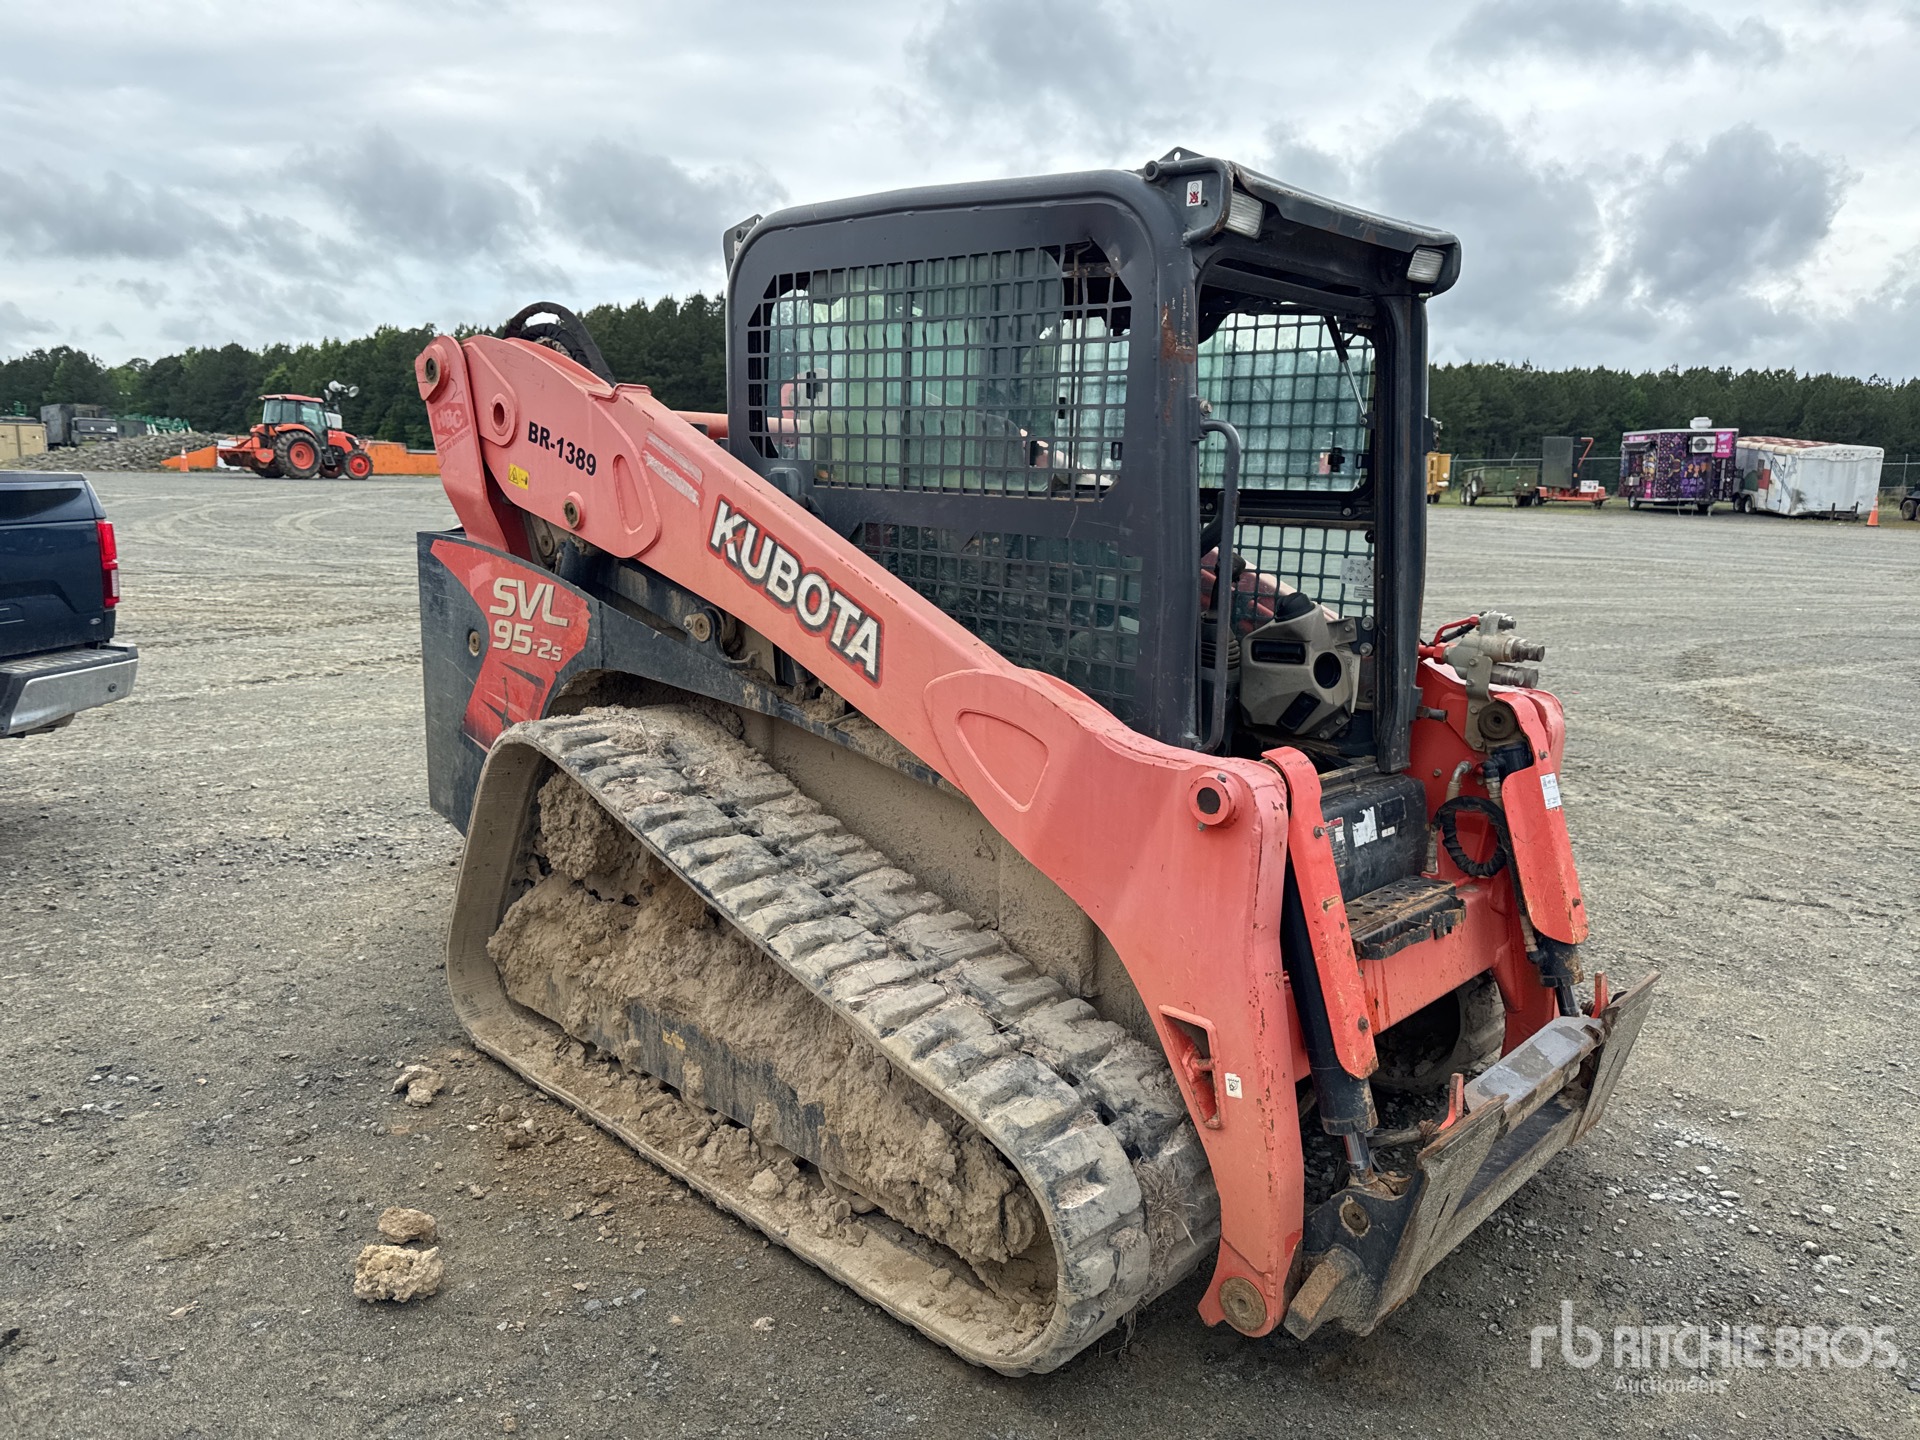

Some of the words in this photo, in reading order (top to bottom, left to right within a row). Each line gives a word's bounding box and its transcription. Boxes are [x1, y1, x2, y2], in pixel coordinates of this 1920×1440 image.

[528, 421, 597, 476] BR-1389
[489, 577, 569, 627] SVL
[710, 500, 878, 676] KUBOTA
